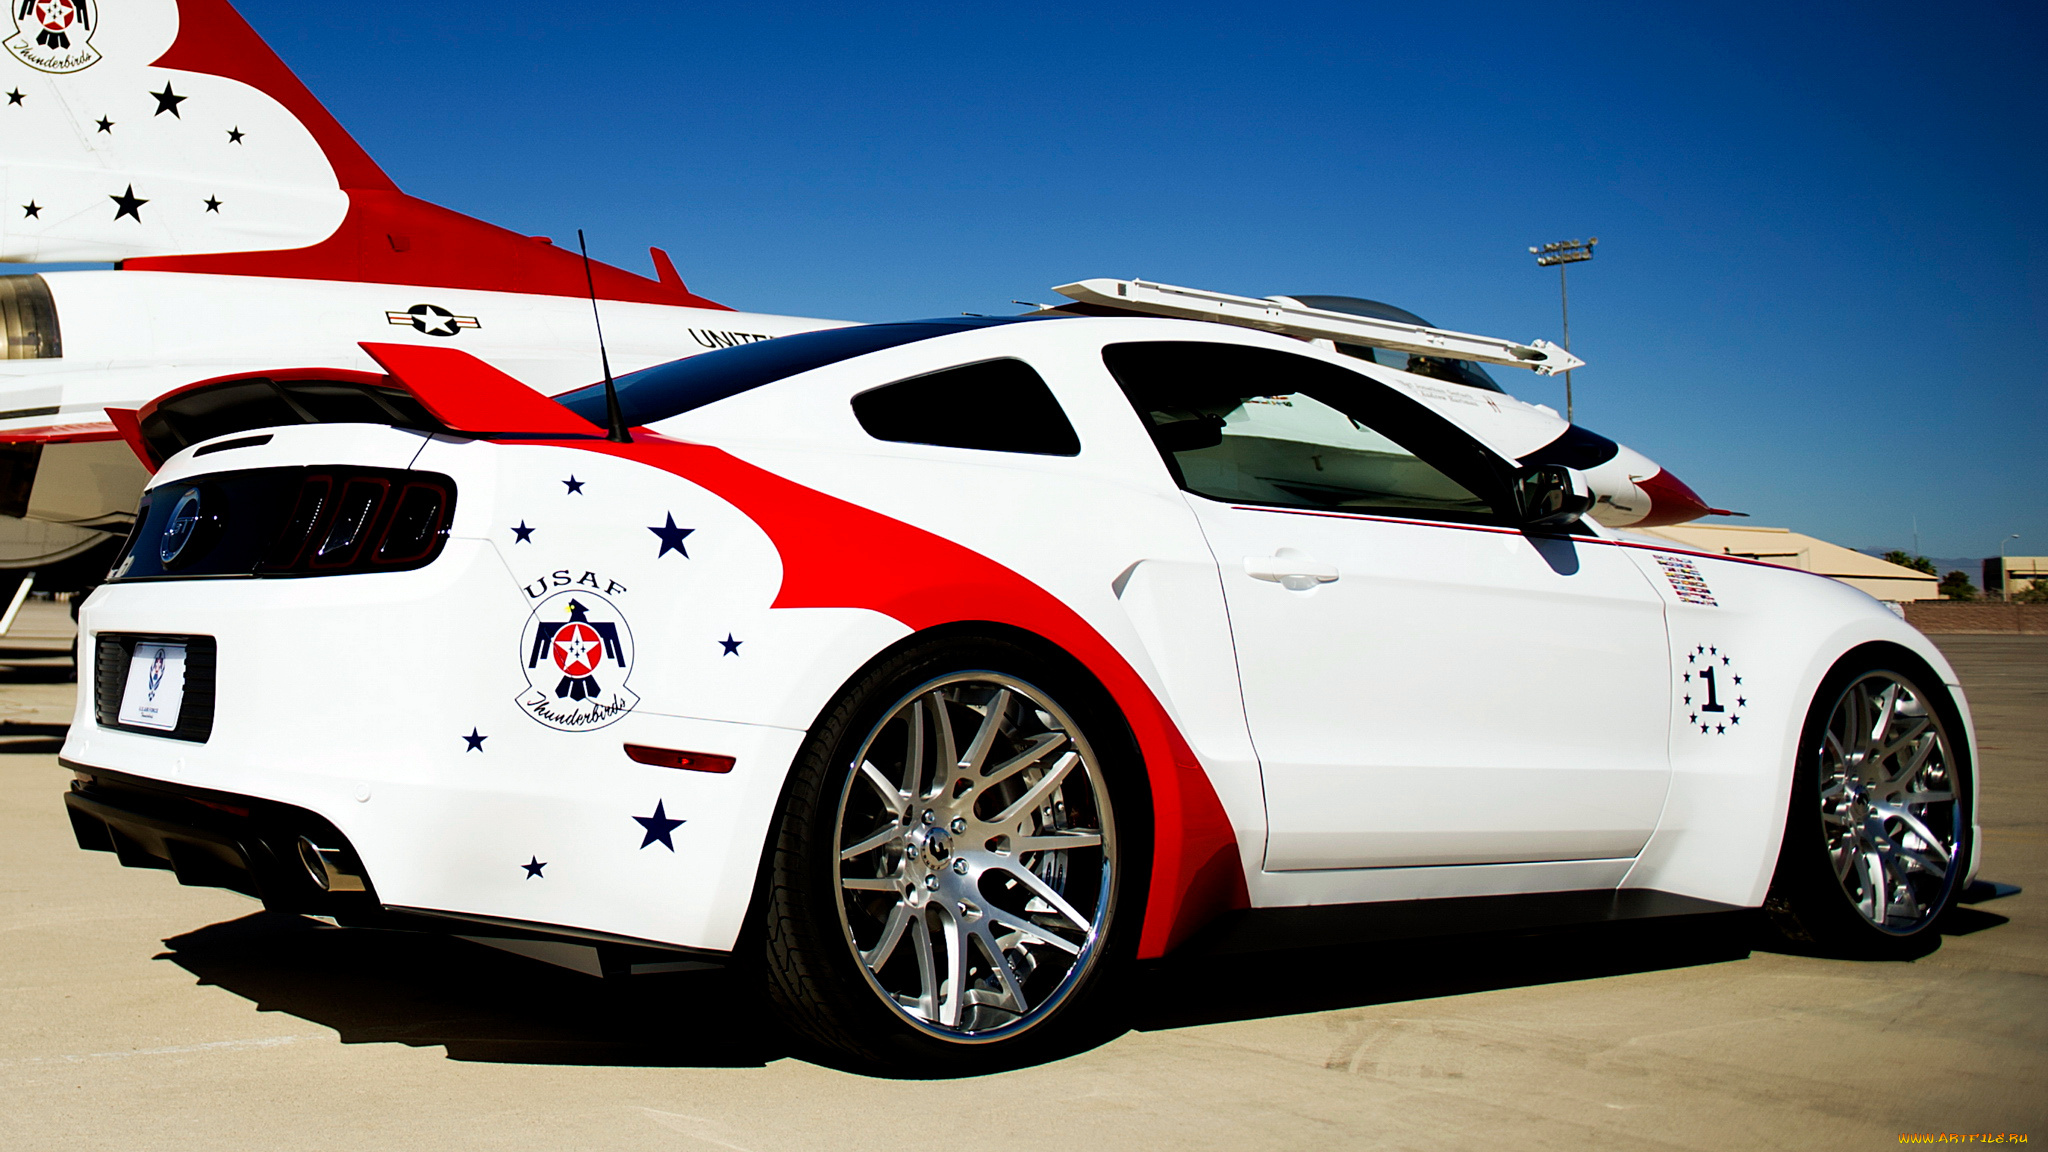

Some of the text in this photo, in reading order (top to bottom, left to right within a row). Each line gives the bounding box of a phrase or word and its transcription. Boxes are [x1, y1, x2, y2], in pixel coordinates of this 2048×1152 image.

[13, 38, 92, 69] Thunderbirds
[523, 569, 628, 599] USAF
[1699, 665, 1725, 713] 1
[526, 690, 626, 727] Thunderbirds
